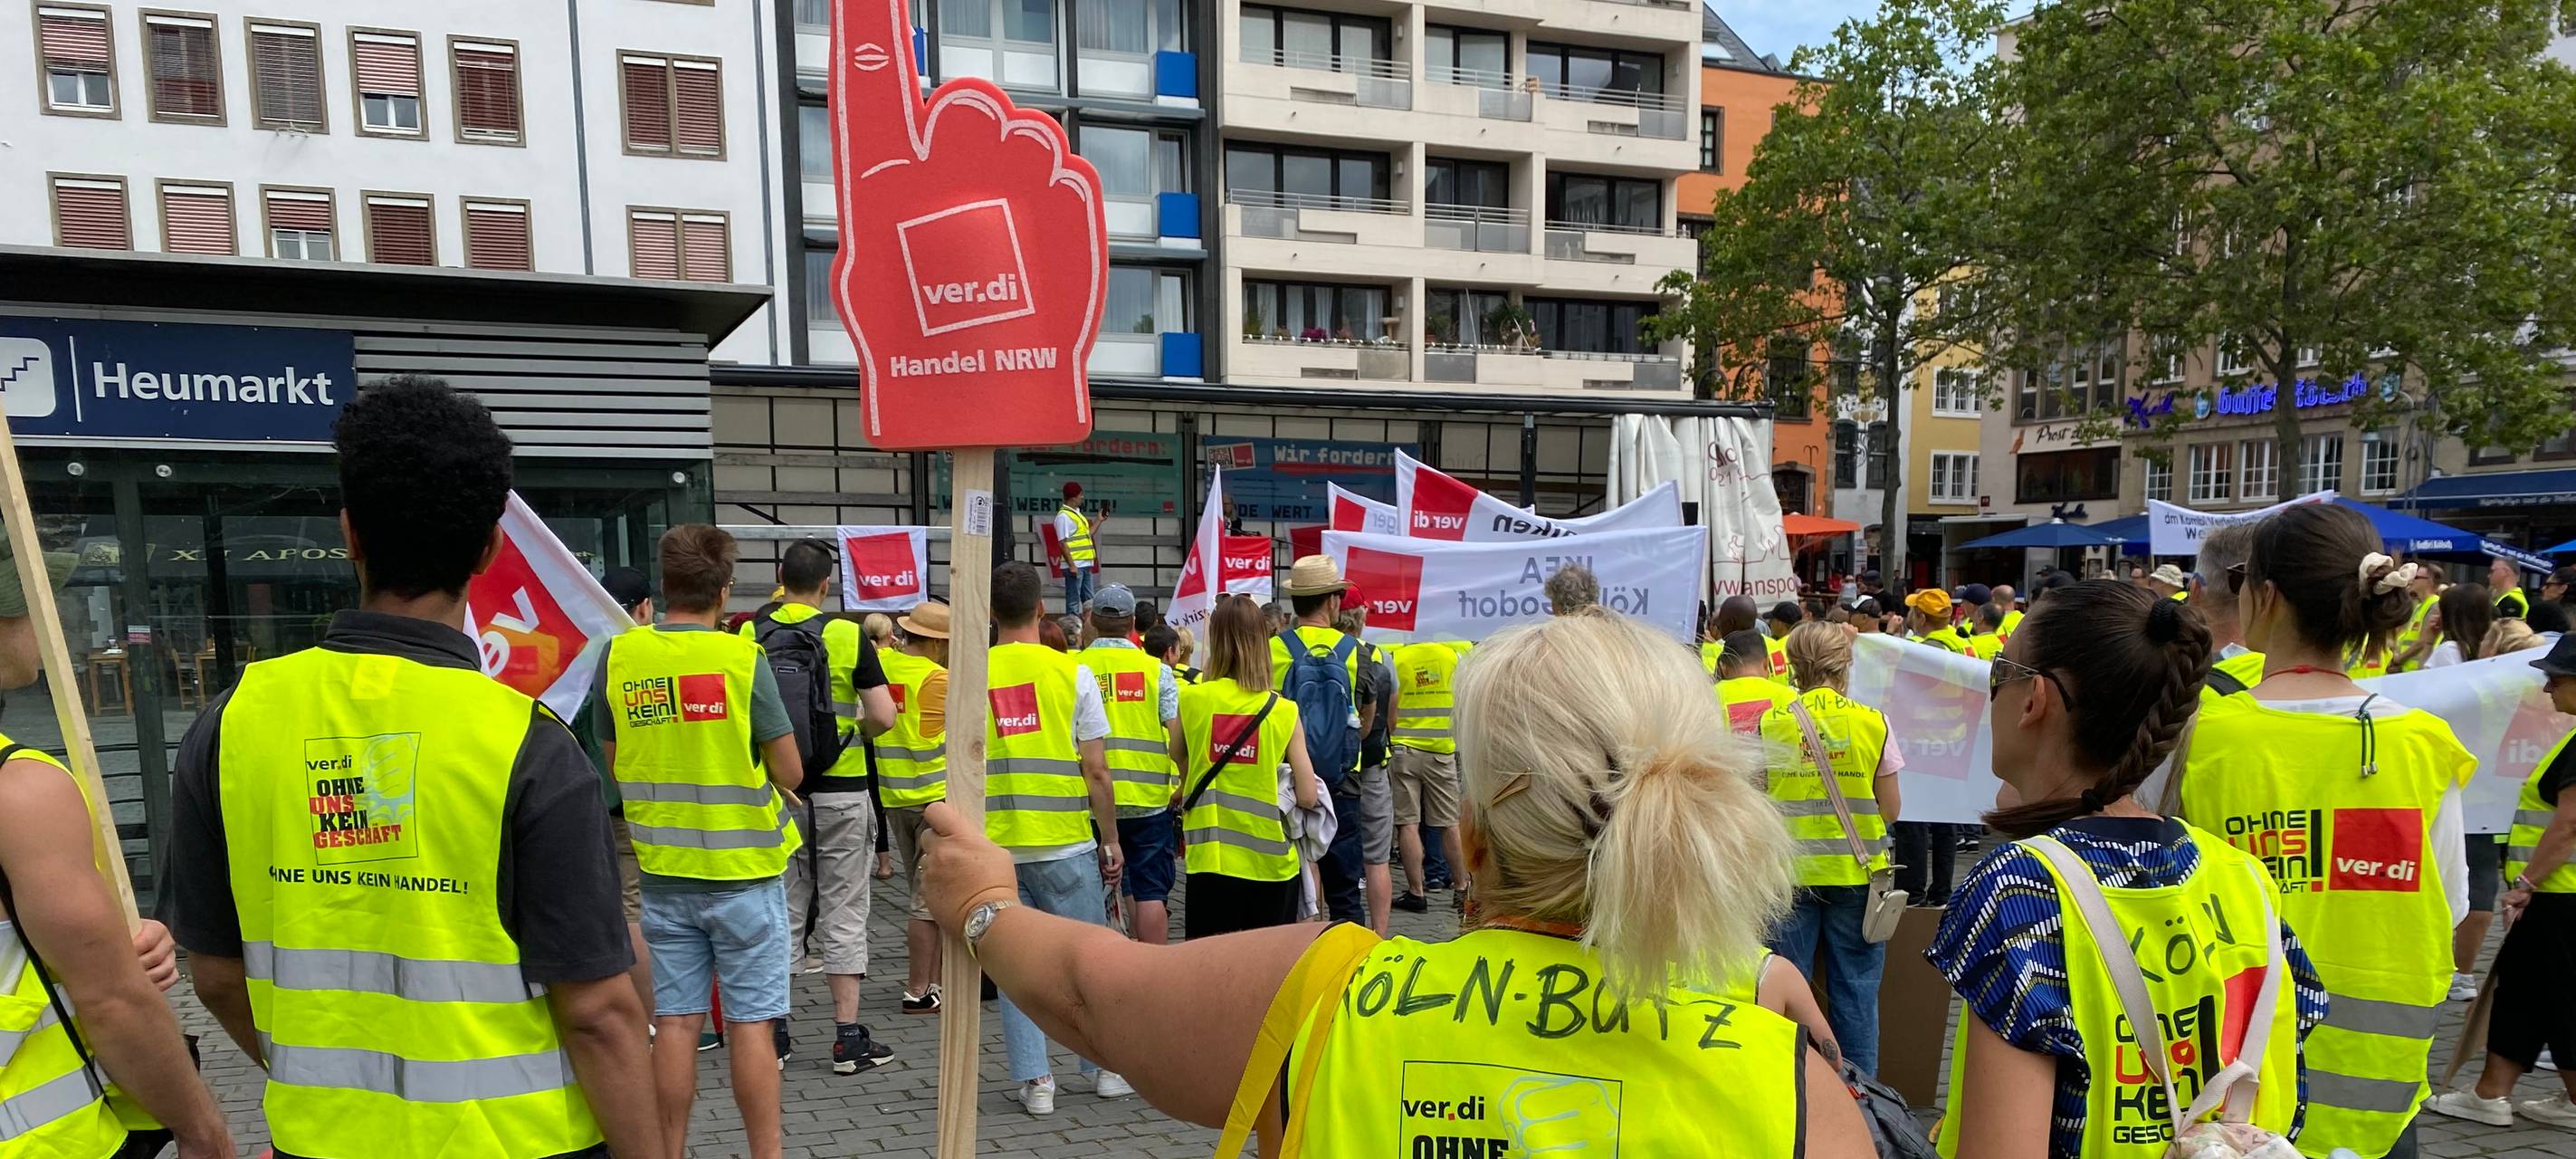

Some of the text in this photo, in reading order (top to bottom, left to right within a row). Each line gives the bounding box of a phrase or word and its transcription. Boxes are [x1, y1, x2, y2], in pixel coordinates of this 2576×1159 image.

[922, 273, 1018, 305] ver.di
[890, 347, 1058, 378] Handel NRW
[92, 361, 334, 406] Heumarkt
[1274, 445, 1311, 463] Wir
[1272, 505, 1312, 519] WERT
[2164, 511, 2179, 524] dm
[858, 570, 914, 587] ver.di
[622, 676, 666, 693] OHNE
[624, 688, 668, 706] UNS
[626, 703, 671, 720] KEIN
[997, 713, 1036, 727] ver.di
[306, 755, 352, 771] ver.di
[317, 777, 365, 798] OHNE
[310, 794, 356, 815] UNS
[320, 809, 368, 832] KEIN
[2225, 809, 2307, 836] OHNE
[313, 823, 402, 849] GESCHÄFT
[2261, 856, 2307, 880] EIN
[2336, 857, 2416, 882] ver.di
[312, 870, 351, 884] UNS
[357, 871, 391, 888] KEIN
[394, 874, 469, 895] HANDEL!
[1402, 1095, 1485, 1122] ver.di
[1412, 1135, 1510, 1159] OHNE
